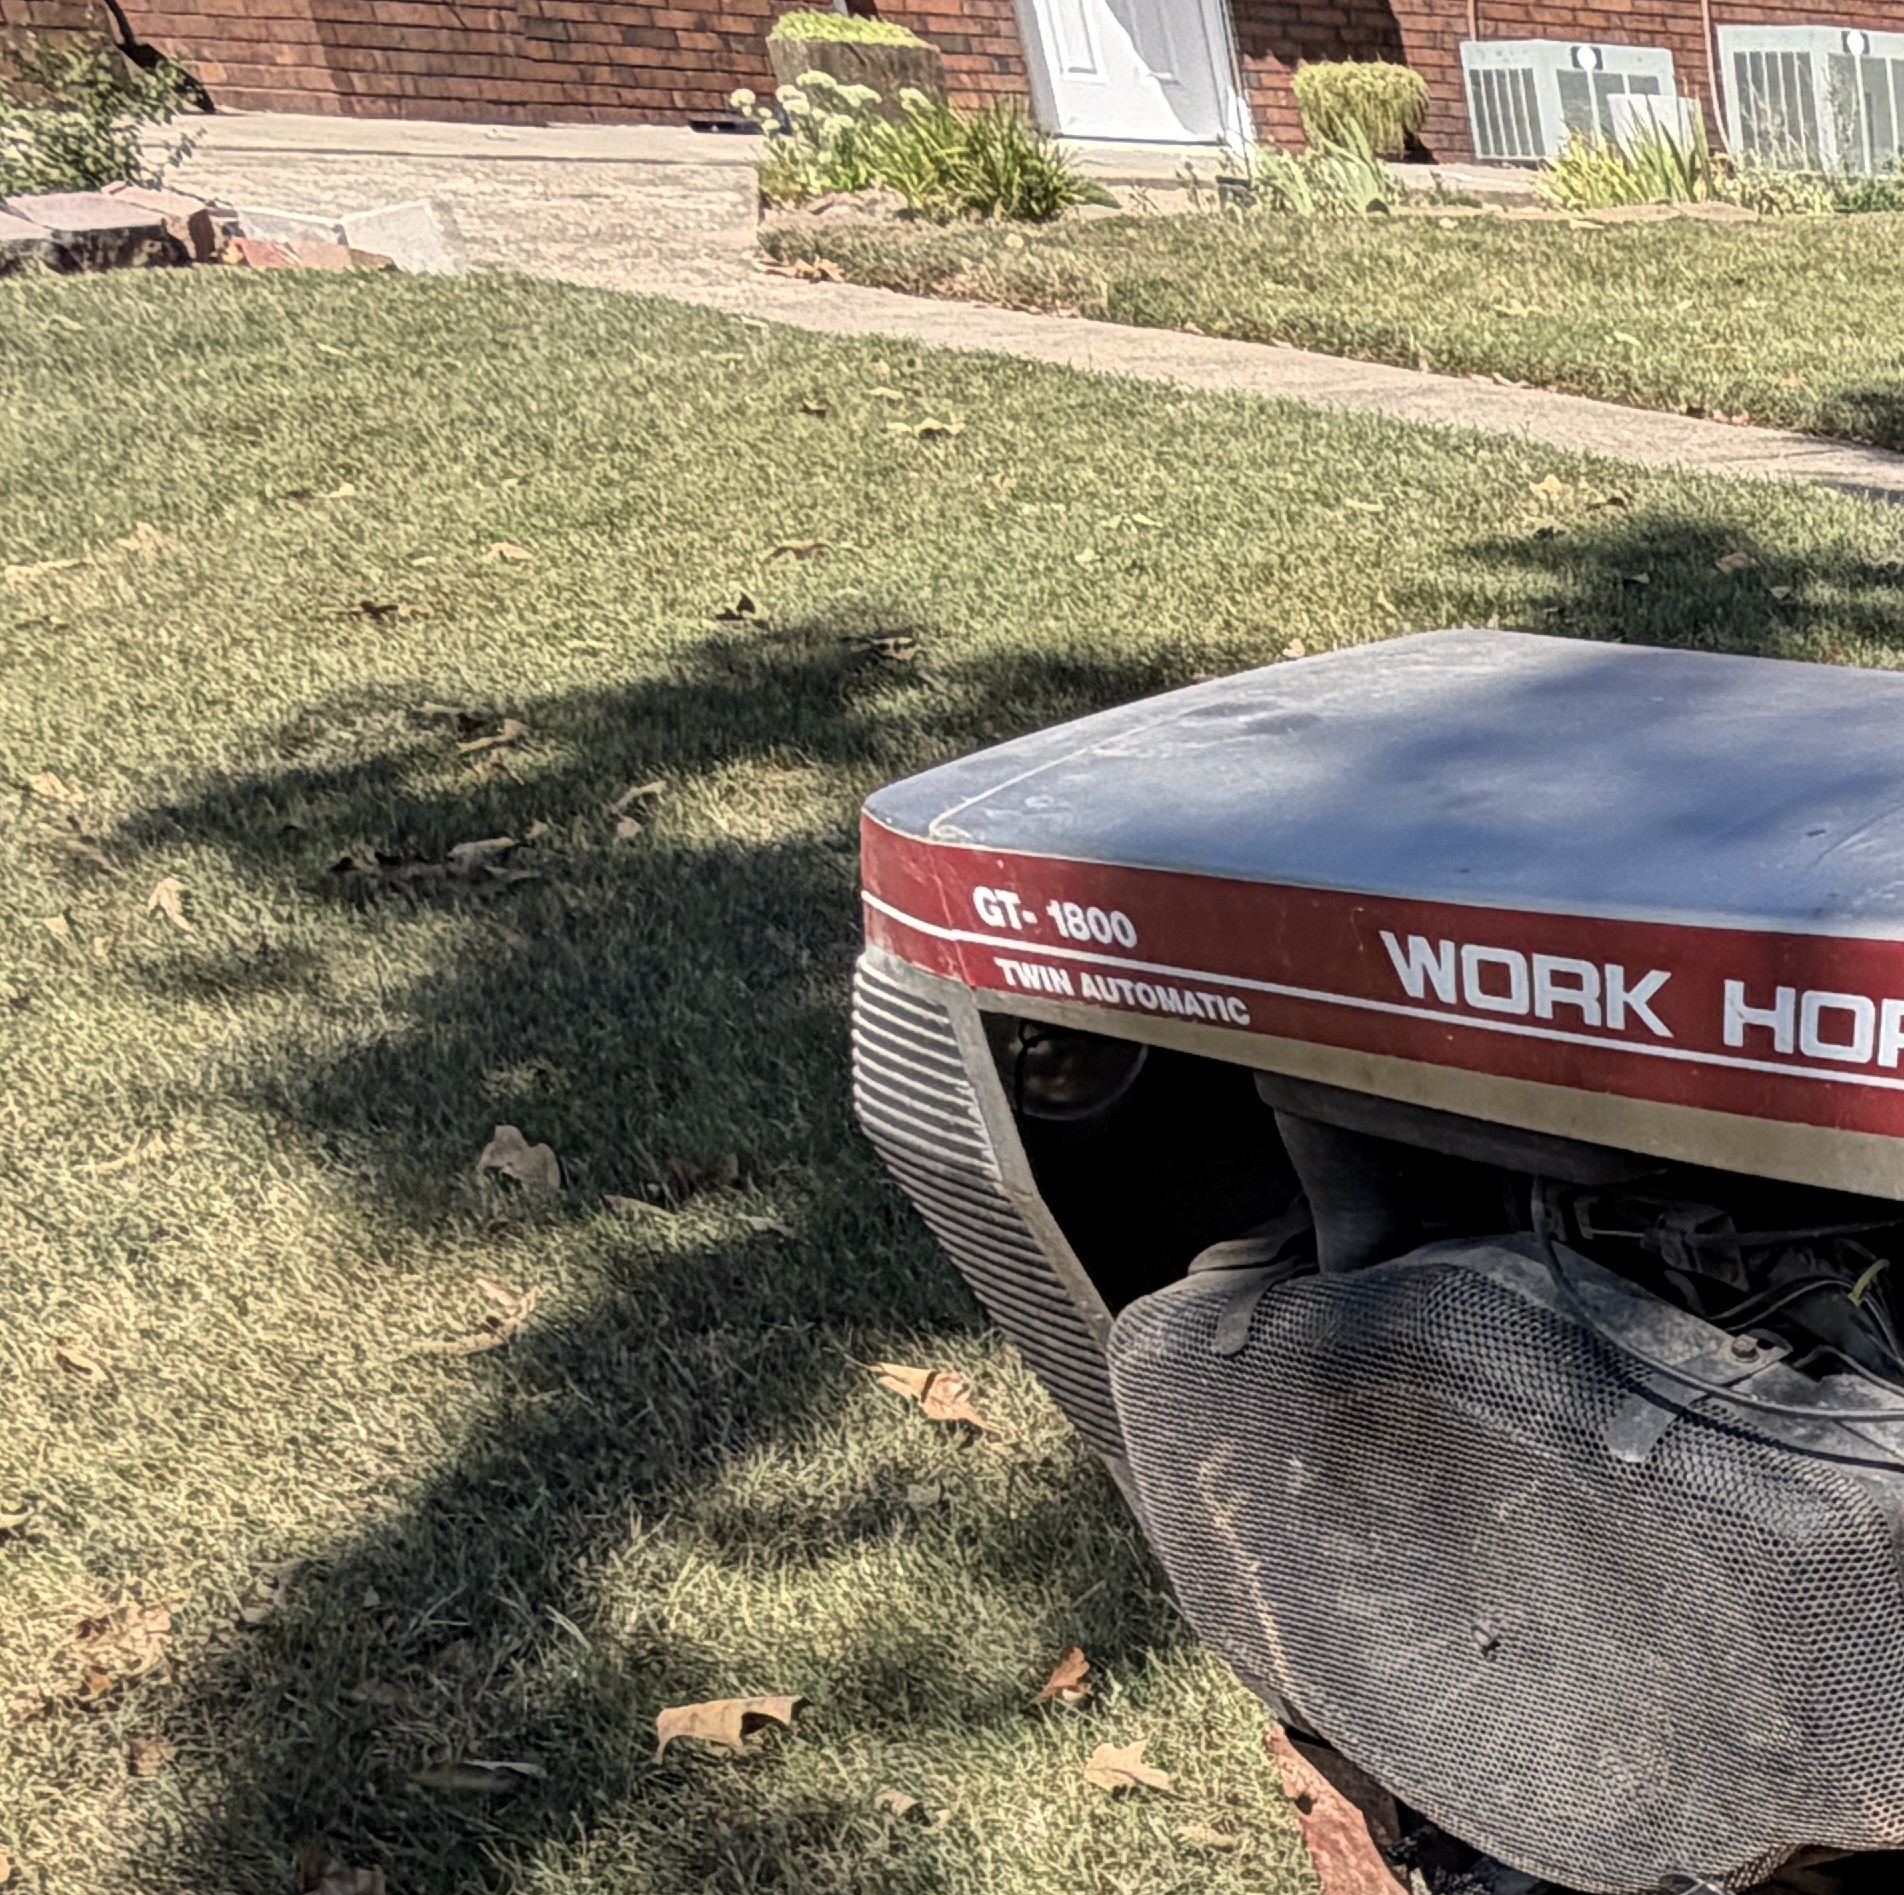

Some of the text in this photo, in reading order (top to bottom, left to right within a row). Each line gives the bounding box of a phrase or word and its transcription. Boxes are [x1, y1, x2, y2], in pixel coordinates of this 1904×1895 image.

[972, 885, 1138, 949] GT- 1800
[994, 957, 1251, 1026] TWIN AUTOMATIC
[1379, 930, 1673, 1039] WORK
